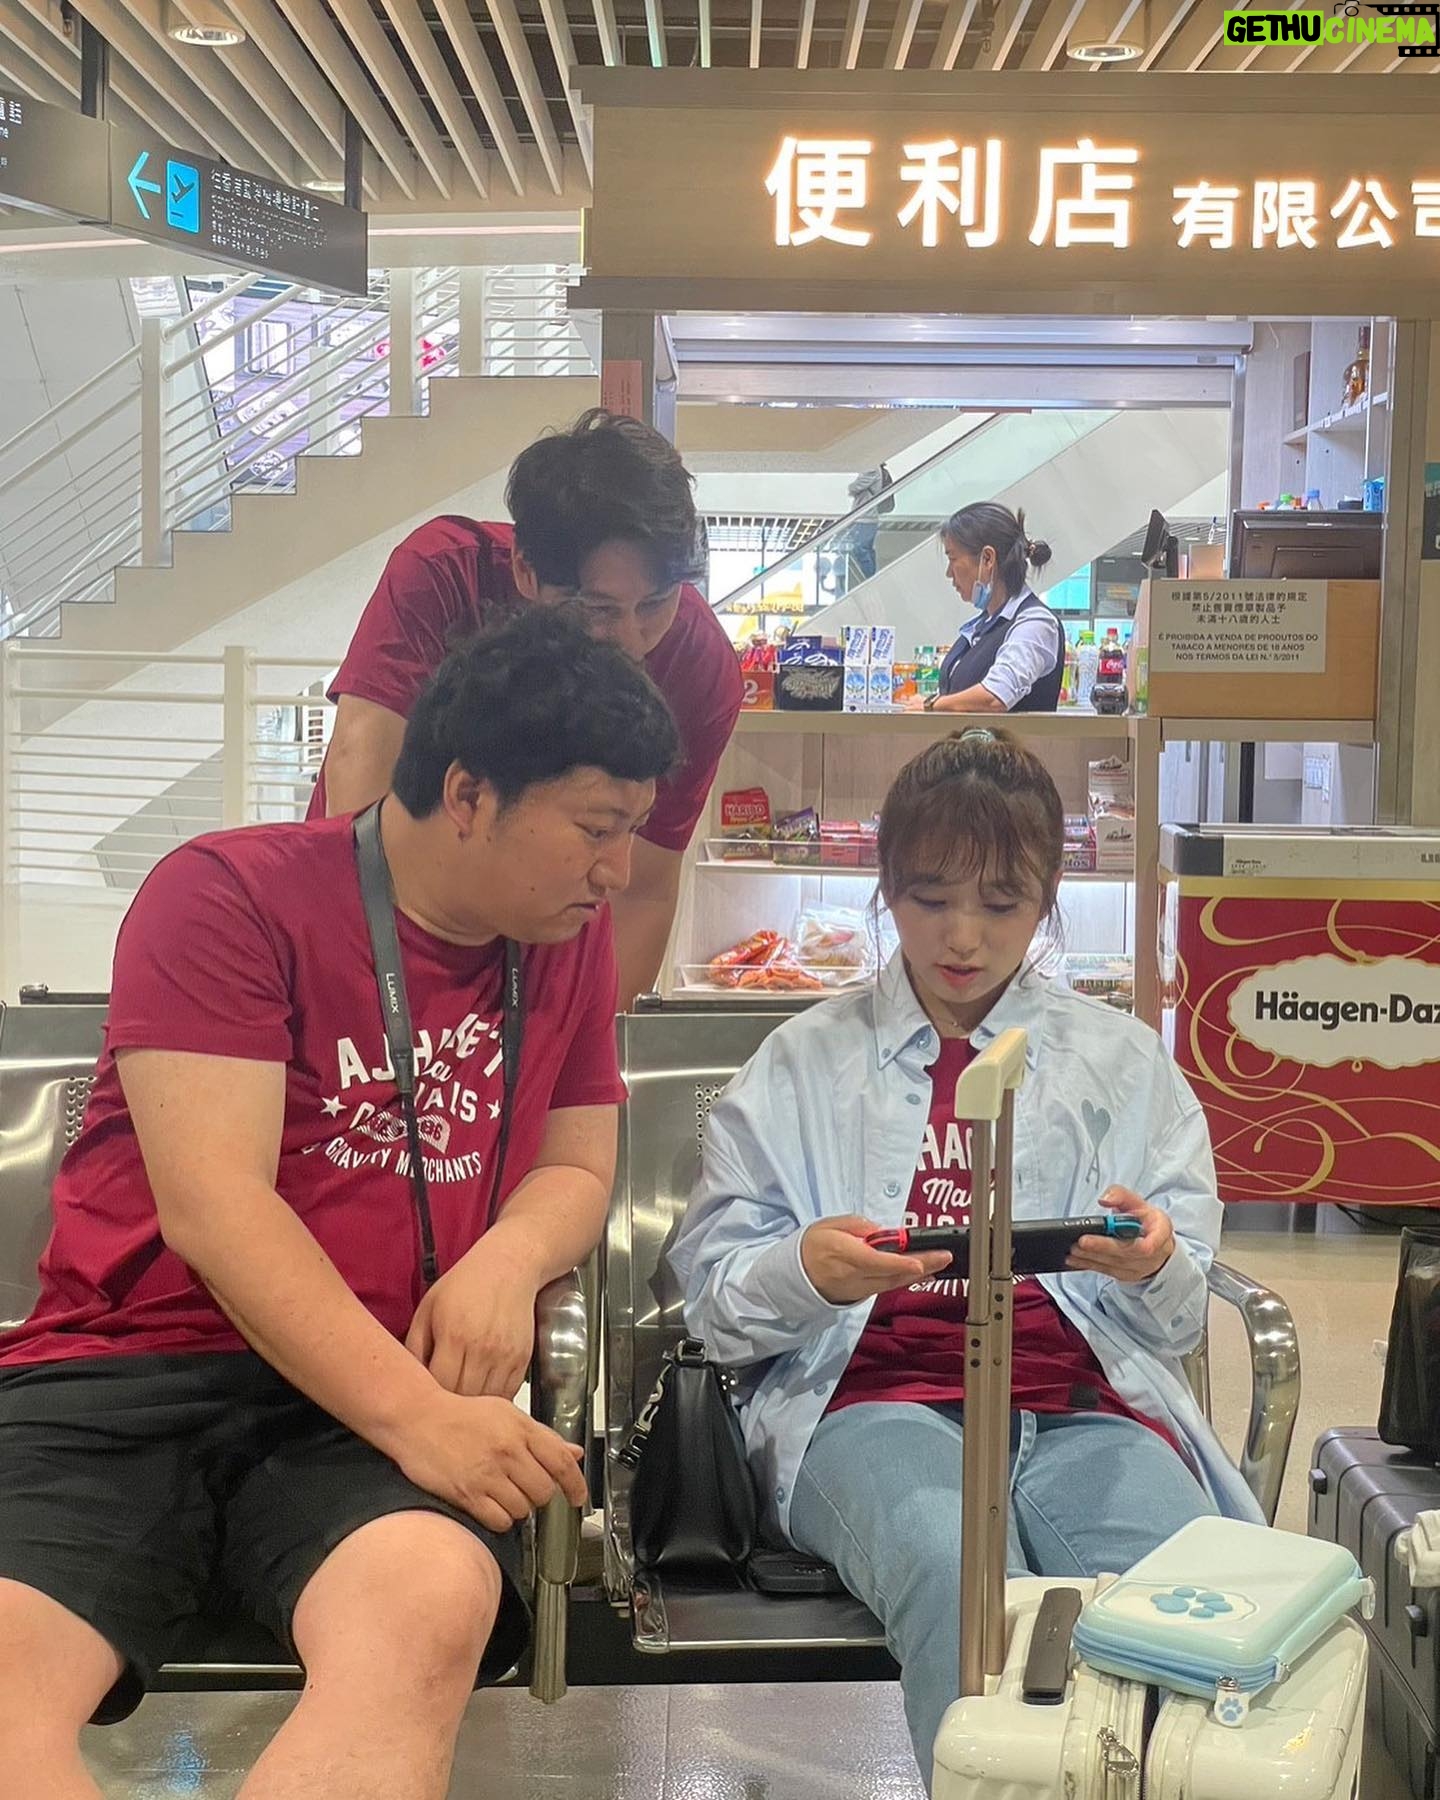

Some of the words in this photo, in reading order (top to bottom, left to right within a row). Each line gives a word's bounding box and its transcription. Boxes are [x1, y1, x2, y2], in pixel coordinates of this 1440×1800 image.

[765, 136, 1138, 249] 便利店
[1166, 632, 1206, 641] PROIBIDA
[1207, 632, 1213, 641] A
[1214, 632, 1243, 641] VENDA
[1244, 632, 1257, 641] DE
[1258, 632, 1304, 641] PRODUTOS
[1305, 632, 1319, 641] DO
[1171, 642, 1205, 652] TABACO
[1206, 642, 1213, 652] A
[1213, 642, 1256, 652] MENORES
[1257, 642, 1269, 652] DE
[1271, 642, 1280, 652] 18
[1281, 642, 1305, 652] ANOS
[1175, 652, 1194, 661] NOS
[1196, 652, 1231, 661] TERMOS
[1232, 652, 1245, 661] DA
[1246, 652, 1259, 661] LEI
[1273, 652, 1300, 661] 5/2011
[386, 972, 399, 1014] LUMIX
[395, 1149, 483, 1183] MRCHANTS
